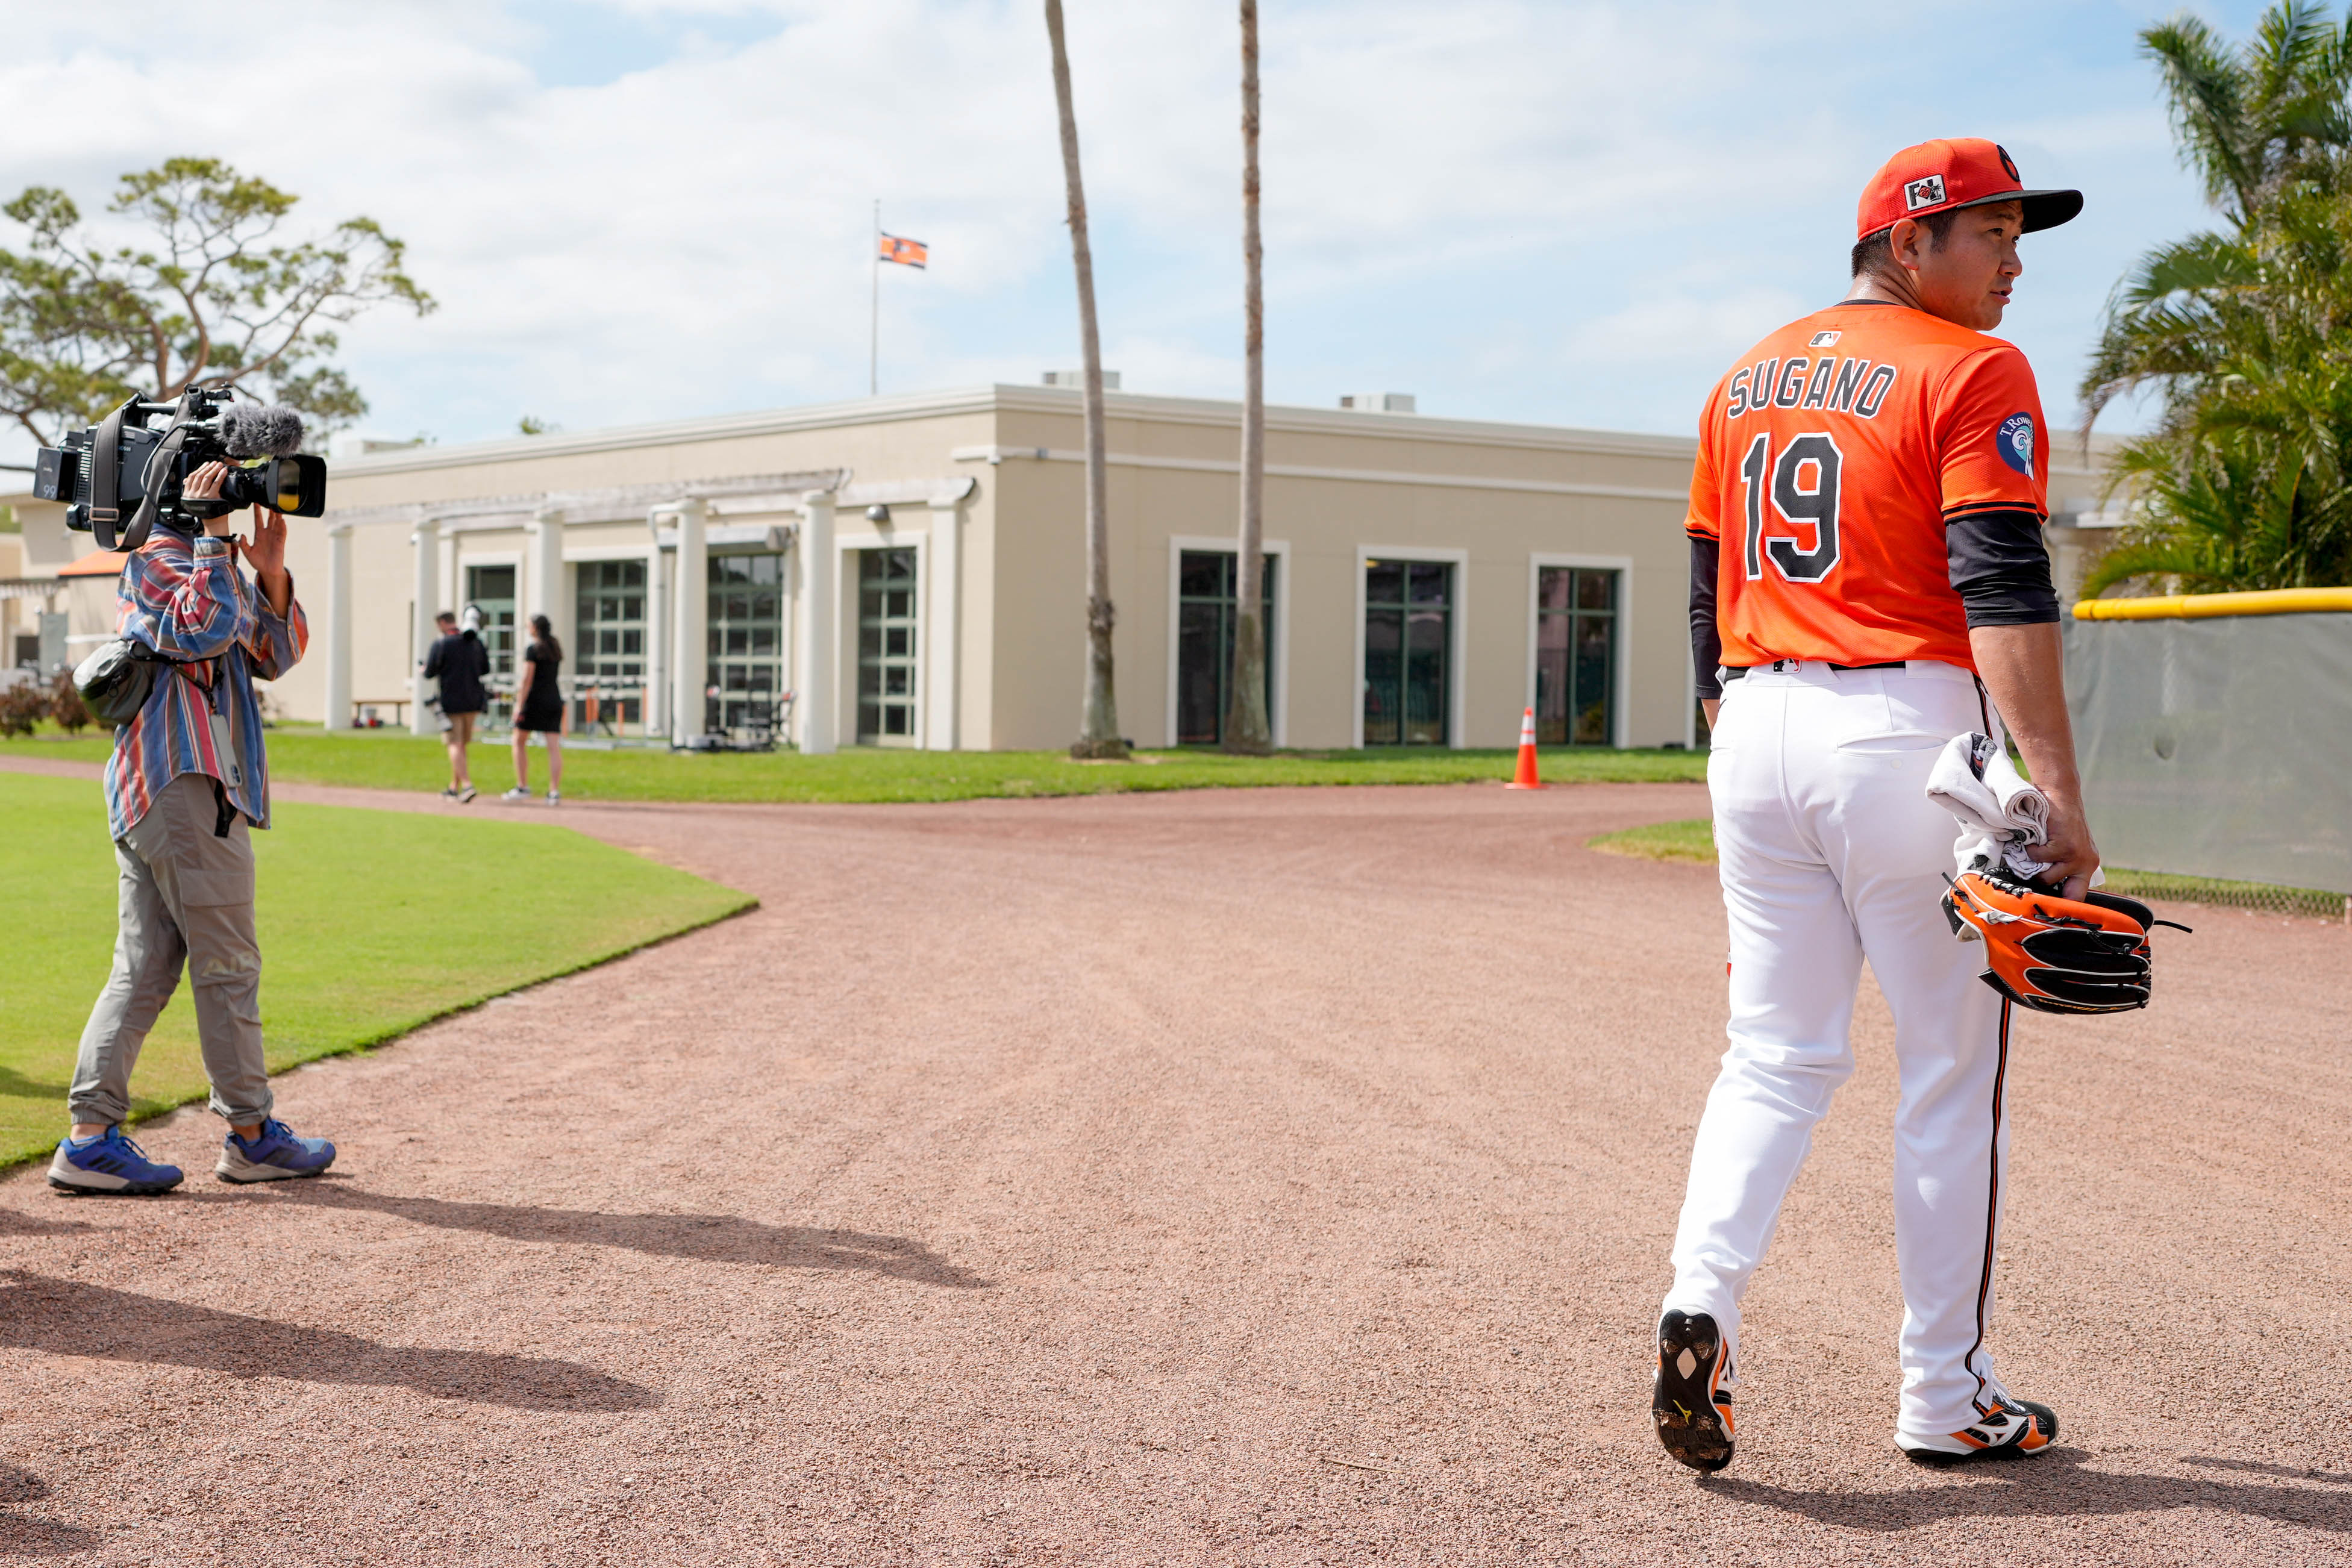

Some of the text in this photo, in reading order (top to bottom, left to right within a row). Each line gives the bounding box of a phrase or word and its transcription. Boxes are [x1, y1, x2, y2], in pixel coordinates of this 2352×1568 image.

[1728, 356, 1897, 419] SUGANO
[43, 484, 56, 498] 99
[1741, 431, 1844, 584] 19
